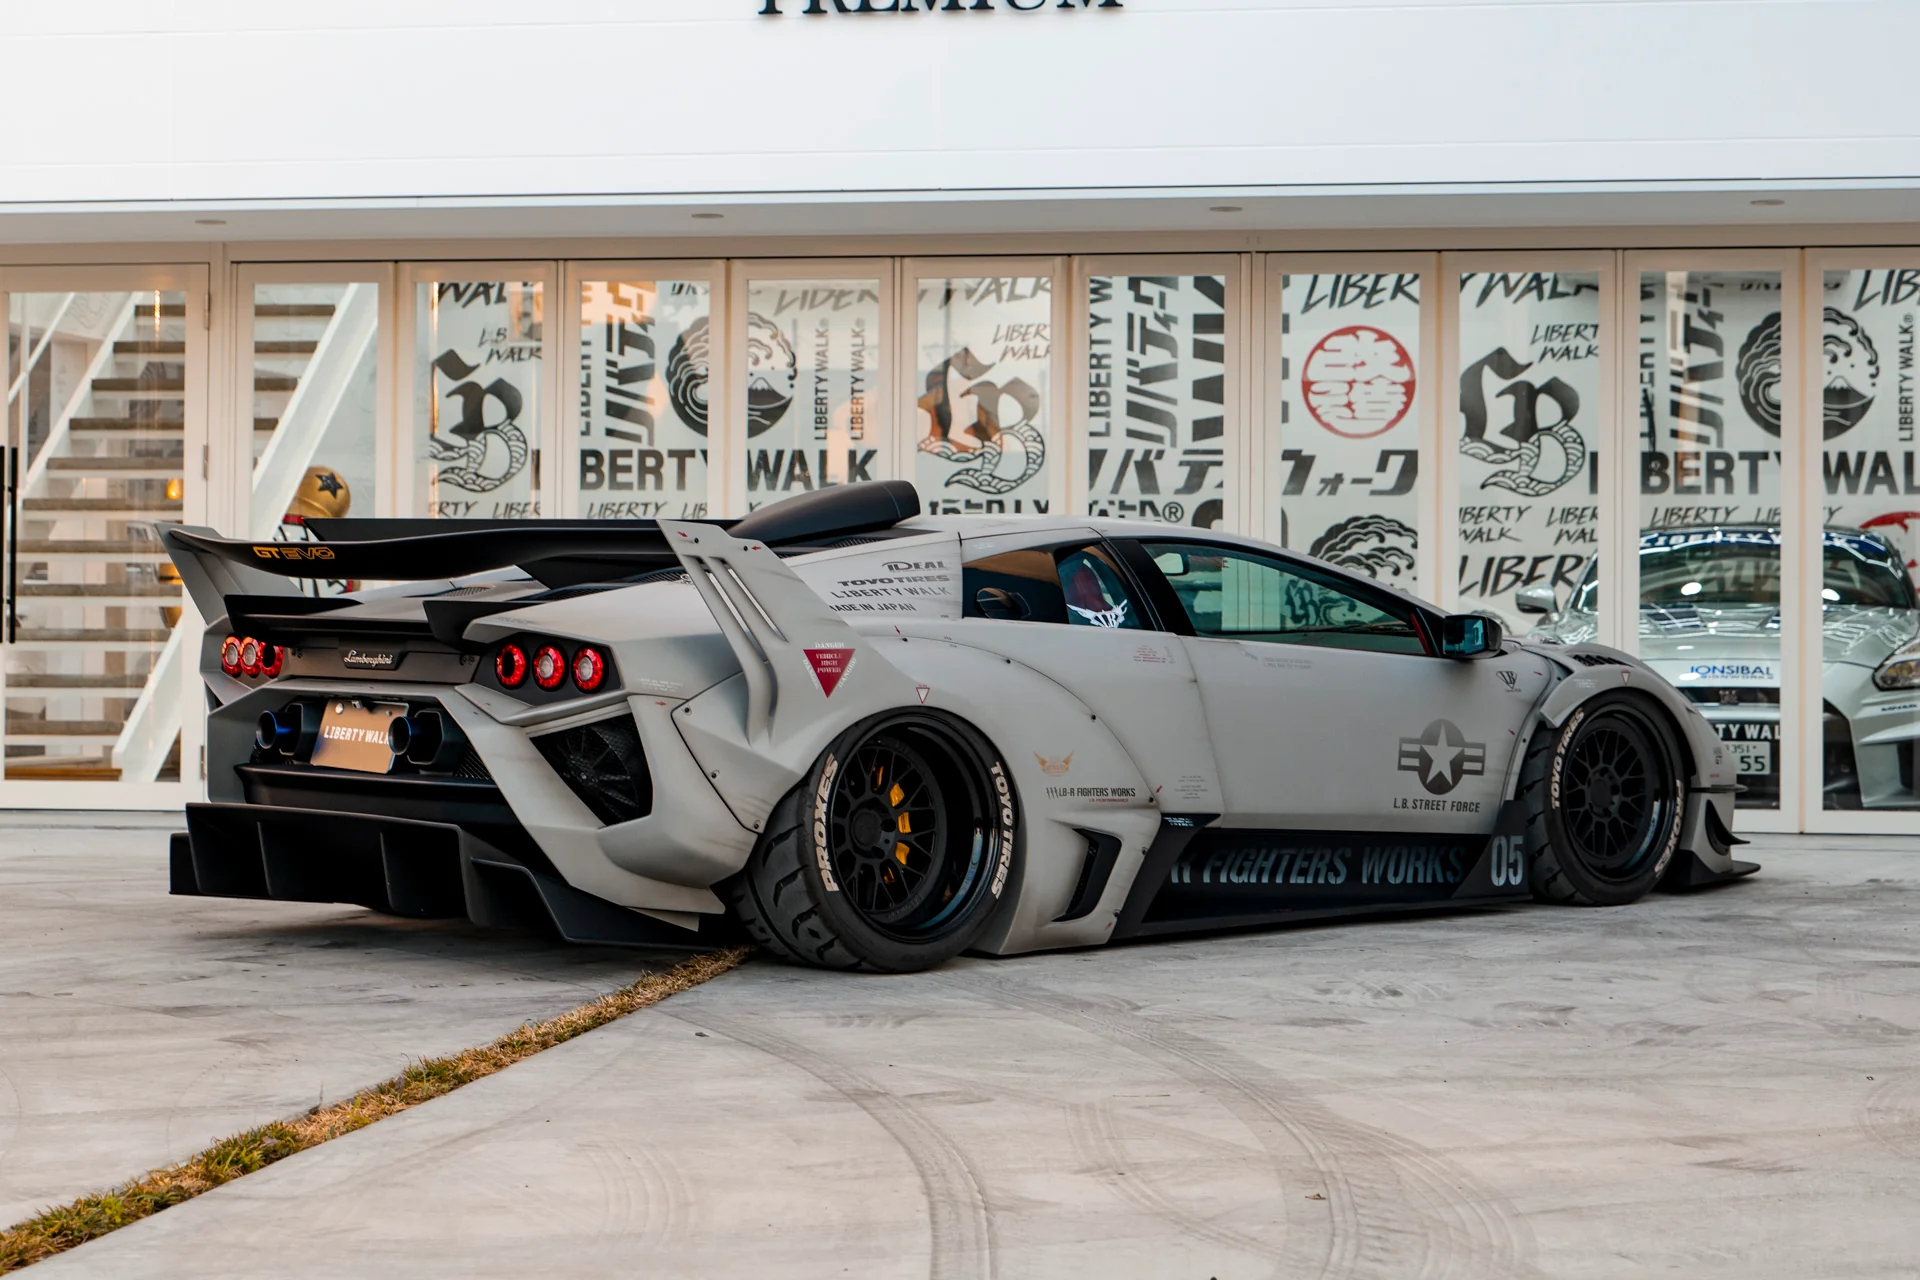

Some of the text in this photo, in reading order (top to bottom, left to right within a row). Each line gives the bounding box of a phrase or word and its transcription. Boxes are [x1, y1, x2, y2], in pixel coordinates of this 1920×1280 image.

[815, 377, 829, 440] LIBERTY
[850, 377, 864, 440] LIBERTY
[1899, 379, 1915, 442] LIBERTY
[747, 449, 878, 491] WALK
[586, 502, 668, 519] LIBERTY
[1651, 506, 1739, 525] LIBERTY
[253, 546, 280, 558] GT
[882, 561, 946, 572] IDEAL
[837, 575, 950, 587] TOYO TIRES
[831, 586, 953, 599] LIBERTY WALK
[860, 603, 875, 612] IN
[877, 603, 917, 612] JAPAN
[343, 650, 393, 668] Lamborghini
[323, 726, 365, 743] LIBERTY
[1550, 707, 1585, 810] TOYO TIRES
[1058, 787, 1136, 797] LB-R FIGHTERS WORKS
[1393, 798, 1481, 813] L.B. STREET FORCE
[813, 752, 840, 892] PROXES
[990, 760, 1014, 900] TOYO TIRES
[1654, 779, 1684, 878] PROXES
[1202, 847, 1352, 885] FIGHTERS
[1361, 847, 1467, 885] WORKS
[1489, 836, 1524, 886] 05
